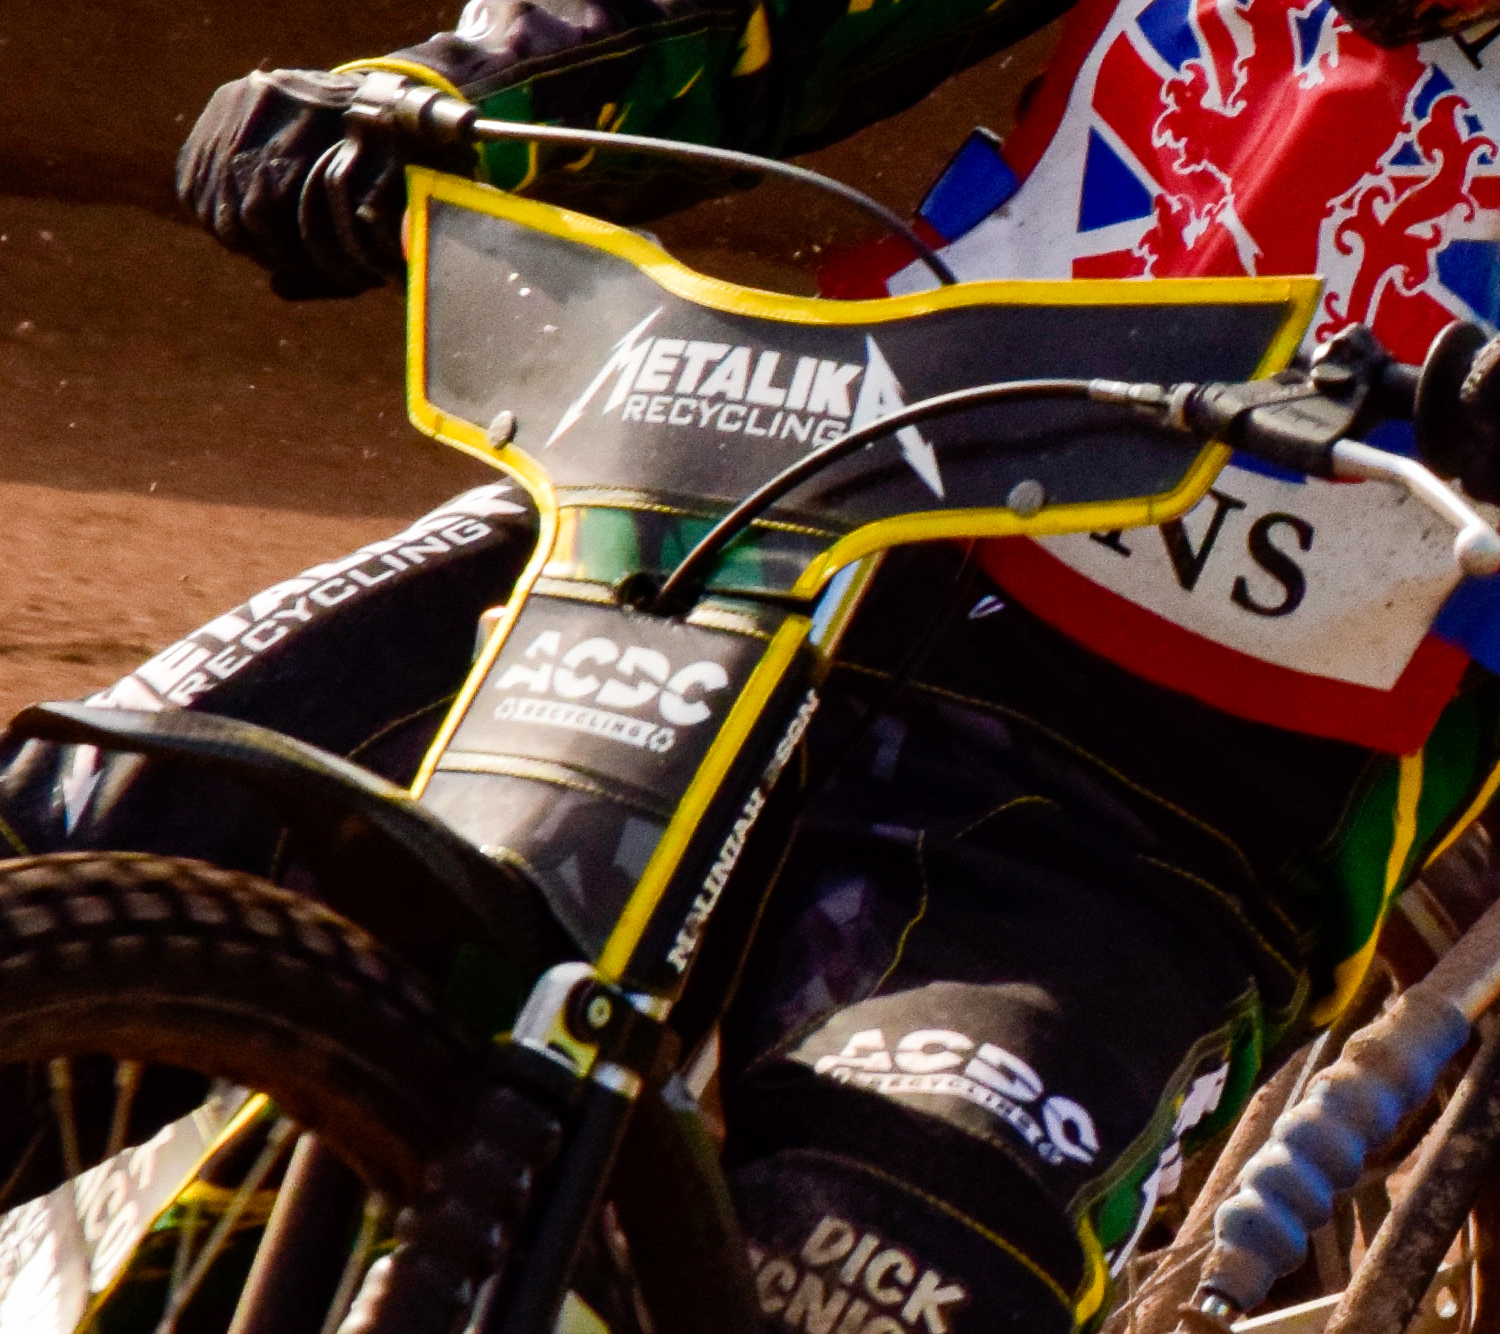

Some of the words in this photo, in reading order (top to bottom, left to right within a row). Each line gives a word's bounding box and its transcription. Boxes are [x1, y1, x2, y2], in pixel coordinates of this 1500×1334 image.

[545, 307, 945, 500] METALIKA
[621, 393, 852, 449] RECYCLING
[166, 518, 493, 707] RECYCLING
